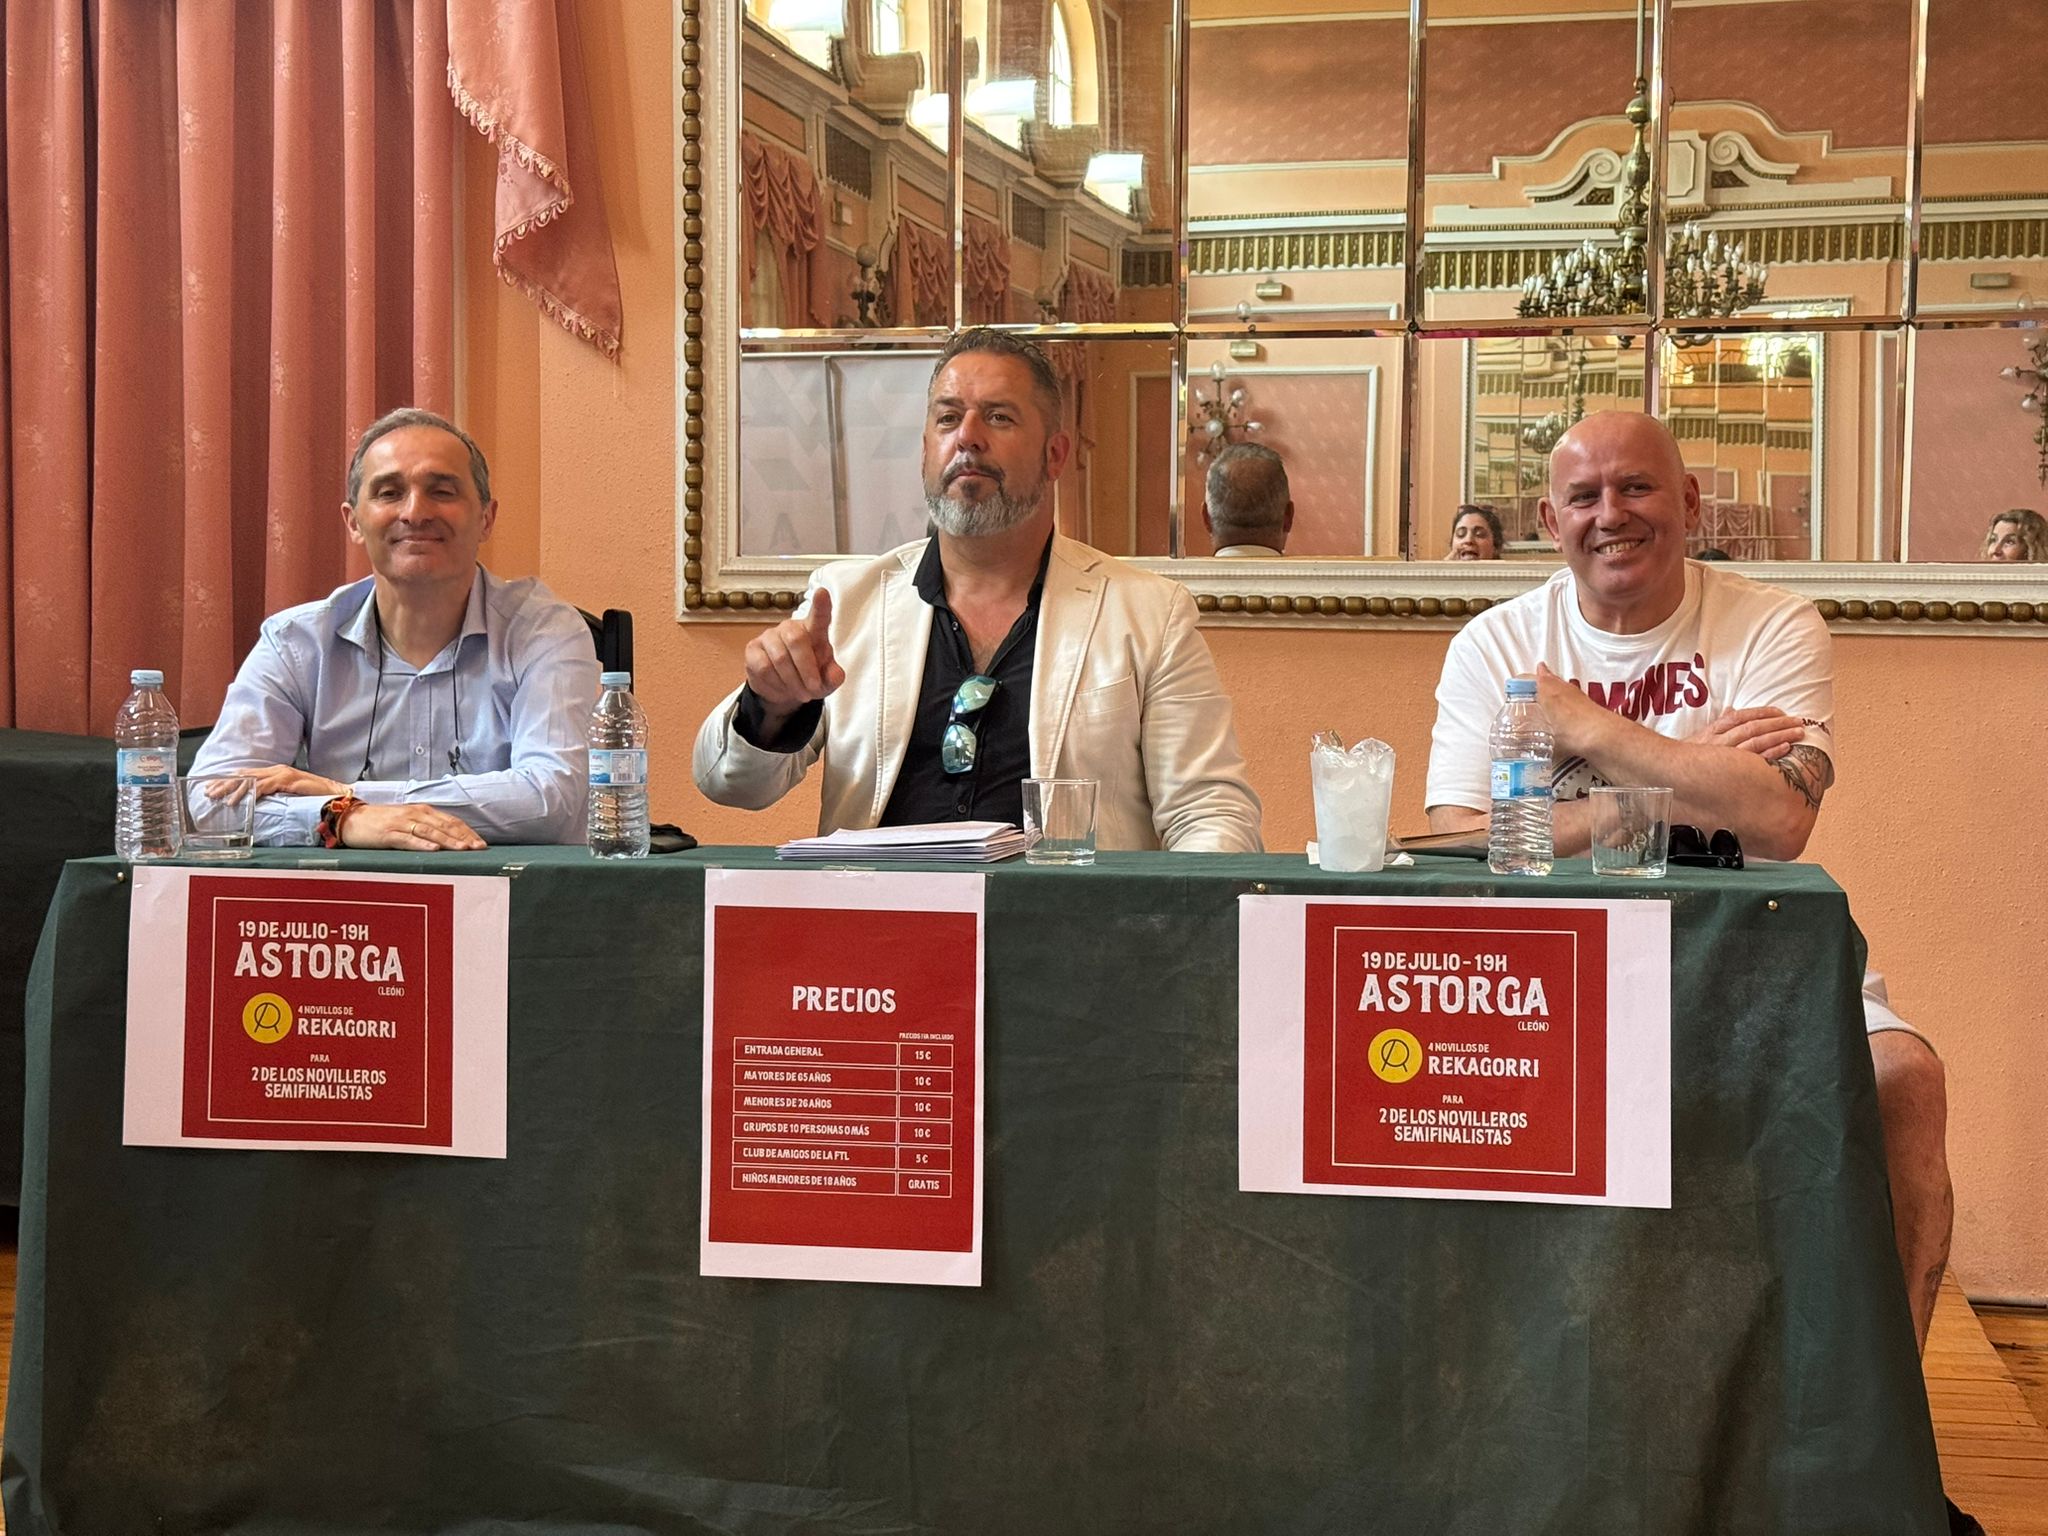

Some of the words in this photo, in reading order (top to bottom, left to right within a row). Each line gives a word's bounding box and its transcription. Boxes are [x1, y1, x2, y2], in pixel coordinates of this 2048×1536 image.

[239, 921, 256, 937] 19
[259, 922, 278, 937] DE
[281, 922, 328, 939] JULIO
[341, 924, 368, 940] 19H
[234, 942, 404, 982] ASTORGA
[1362, 952, 1381, 968] 19
[1385, 952, 1406, 969] DE
[1408, 953, 1460, 970] JULIO
[1475, 954, 1507, 972] 19H
[378, 986, 404, 996] (LEÓN)
[1358, 974, 1549, 1016] ASTORGA
[792, 986, 896, 1013] PRECIOS
[298, 1006, 304, 1014] 4
[304, 1006, 342, 1014] NOVILLOS
[344, 1006, 354, 1016] DE
[298, 1018, 396, 1038] REKAGORRI
[1518, 1020, 1550, 1032] (LEÓN)
[744, 1044, 784, 1056] ENTRADA
[784, 1046, 824, 1056] GENERAL
[1428, 1042, 1434, 1052] 4
[1434, 1042, 1476, 1054] NOVILLOS
[1478, 1044, 1490, 1054] DE
[310, 1054, 330, 1062] PARA
[914, 1050, 924, 1060] 15
[924, 1050, 932, 1060] €
[1429, 1056, 1538, 1077] REKAGORRI
[251, 1067, 259, 1081] 2
[261, 1067, 278, 1081] DE
[280, 1068, 304, 1082] LOS
[306, 1068, 386, 1084] NOVILLEROS
[744, 1070, 784, 1080] MAYORES
[786, 1072, 796, 1082] DE
[808, 1072, 832, 1082] AÑOS
[914, 1076, 924, 1086] 10
[924, 1076, 932, 1086] €
[265, 1084, 372, 1100] SEMIFINALISTAS
[744, 1096, 786, 1106] MENORES
[786, 1098, 798, 1108] DE
[808, 1098, 832, 1108] AÑOS
[1442, 1094, 1464, 1104] PARA
[914, 1102, 924, 1112] 10
[924, 1102, 932, 1112] €
[1380, 1108, 1387, 1123] 2
[1390, 1108, 1407, 1123] DE
[1410, 1109, 1436, 1123] LOS
[1438, 1110, 1527, 1128] NOVILLEROS
[744, 1122, 776, 1132] GRUPOS
[778, 1122, 788, 1132] DE
[790, 1124, 800, 1134] 10
[800, 1124, 844, 1134] PERSONAS
[850, 1124, 870, 1136] MÁS
[914, 1128, 924, 1138] 10
[924, 1128, 930, 1138] €
[1395, 1126, 1511, 1145] SEMIFINALISTAS
[742, 1148, 766, 1158] CLUB
[766, 1148, 776, 1158] DE
[776, 1148, 810, 1160] AMIGOS
[810, 1150, 822, 1160] DE
[822, 1150, 834, 1160] LA
[834, 1150, 850, 1160] FTL
[916, 1154, 922, 1164] 5
[922, 1154, 928, 1164] €
[742, 1172, 768, 1184] NIÑOS
[768, 1174, 810, 1184] MENORES
[810, 1176, 822, 1186] DE
[824, 1176, 834, 1186] 18
[834, 1176, 856, 1186] AÑOS
[908, 1178, 940, 1190] GRATIS
